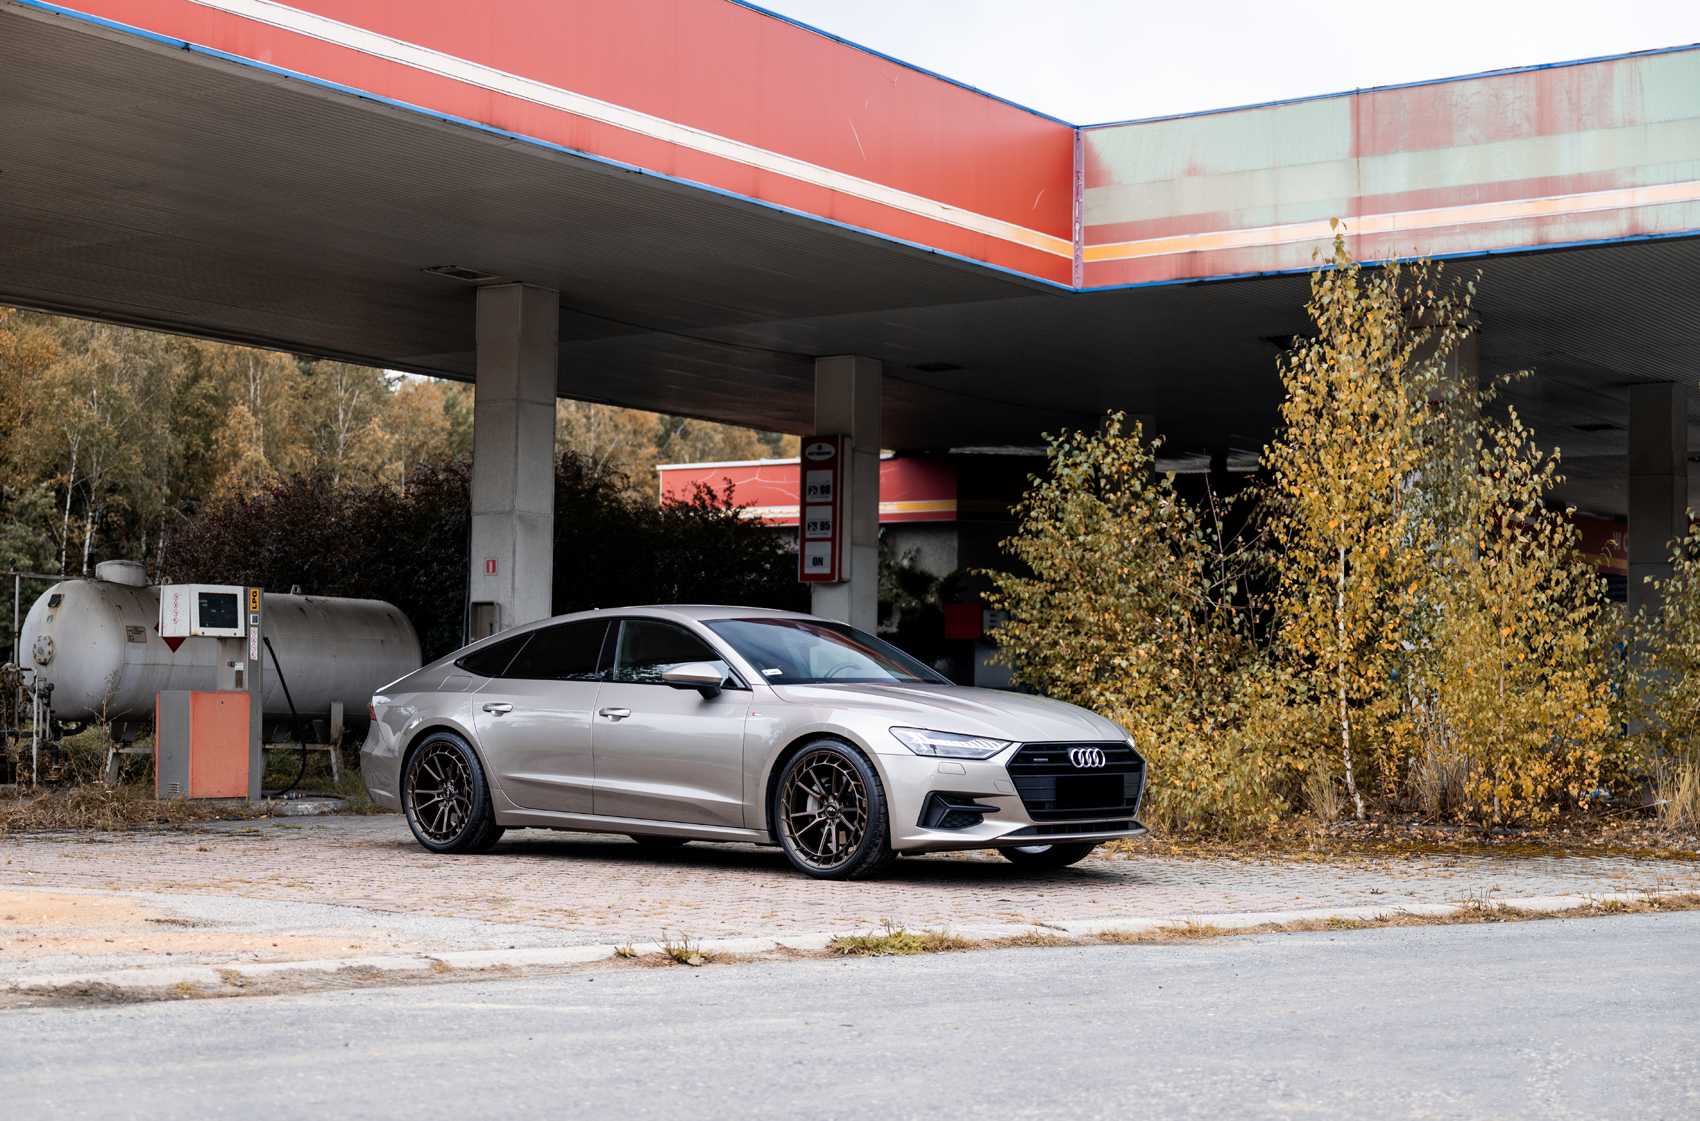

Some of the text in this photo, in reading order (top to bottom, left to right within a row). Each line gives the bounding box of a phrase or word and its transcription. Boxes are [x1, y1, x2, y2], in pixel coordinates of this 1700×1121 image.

[820, 484, 830, 495] 98
[820, 521, 830, 531] 95
[812, 556, 824, 566] ON
